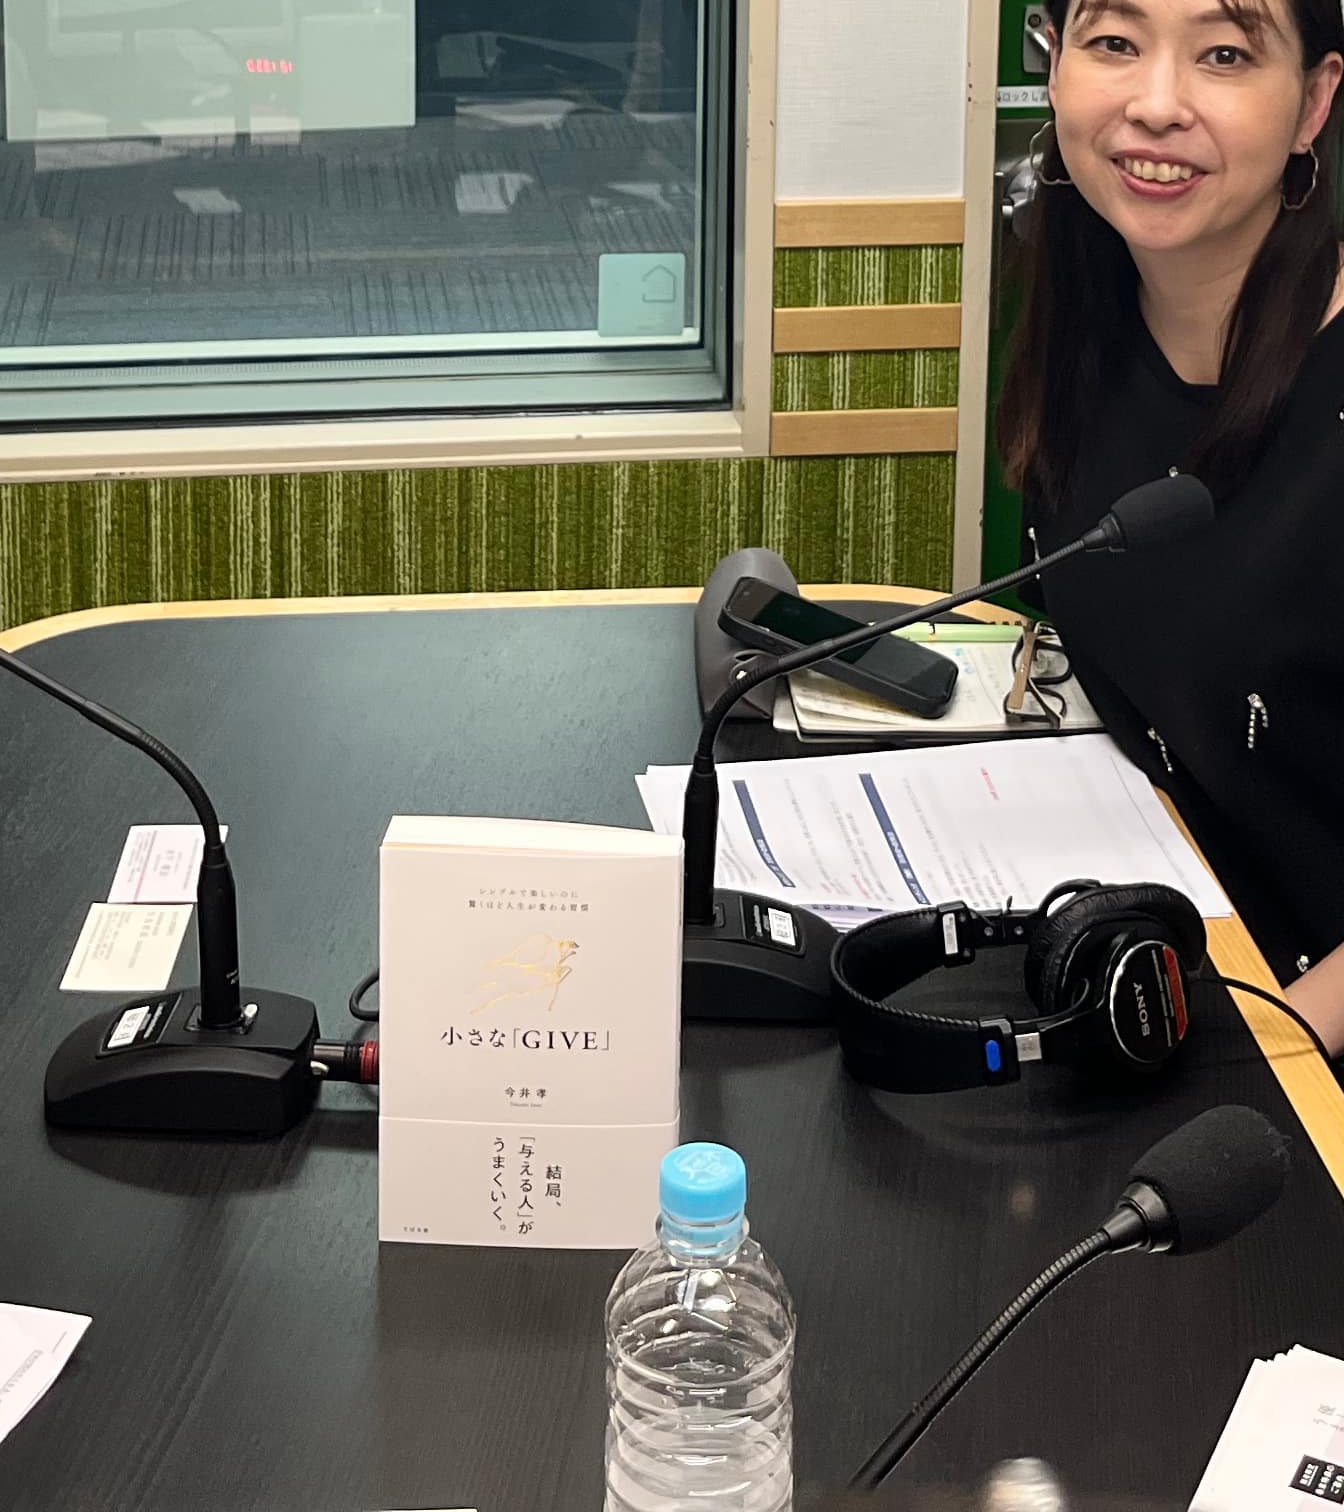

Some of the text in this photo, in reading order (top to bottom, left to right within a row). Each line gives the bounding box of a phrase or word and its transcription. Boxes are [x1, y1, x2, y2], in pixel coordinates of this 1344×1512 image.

[1133, 982, 1151, 1037] SONY
[440, 1026, 610, 1051] 小さな「GIVE」
[491, 1136, 506, 1231] うまくいく。
[517, 1136, 536, 1234] 「与える人」が
[545, 1165, 562, 1207] 結局、
